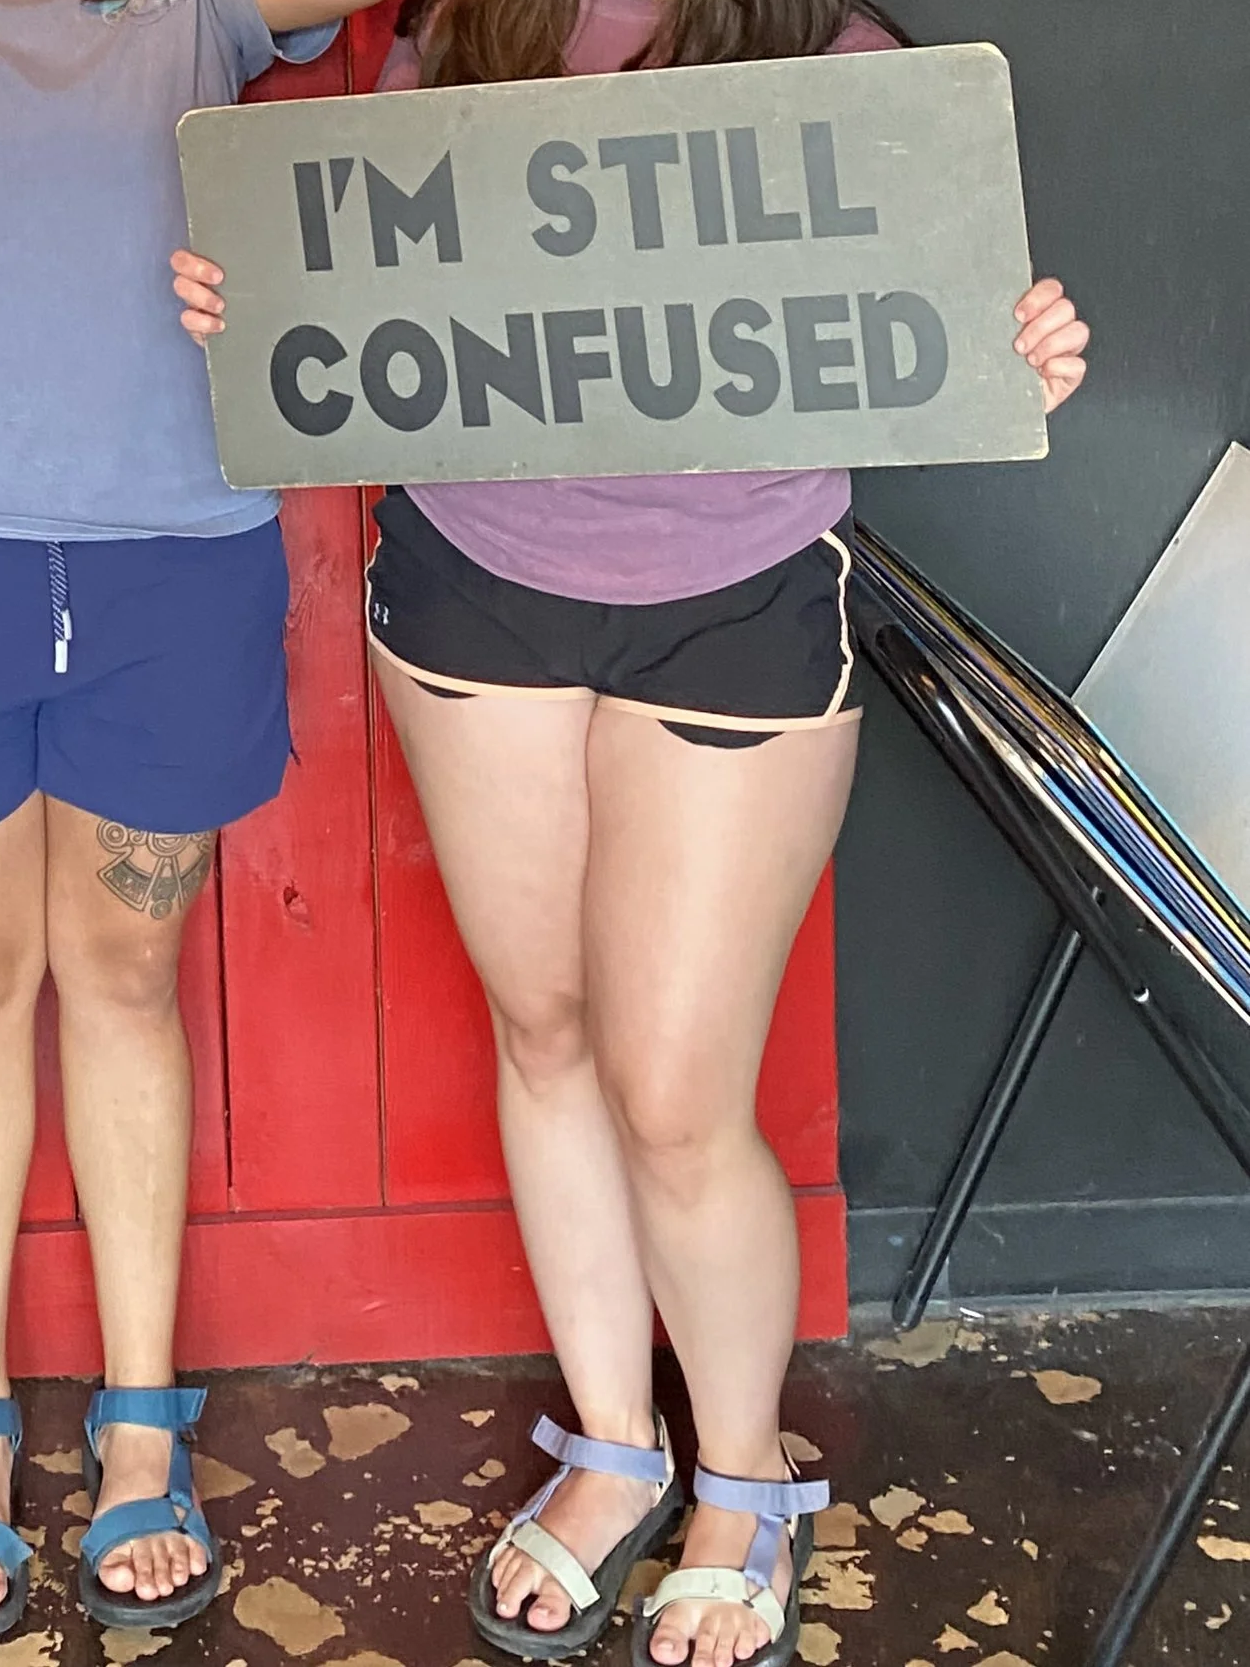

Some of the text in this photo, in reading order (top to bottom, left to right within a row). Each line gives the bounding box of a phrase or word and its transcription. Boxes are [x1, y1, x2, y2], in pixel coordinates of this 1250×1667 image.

[292, 121, 879, 272] I'M STILL
[270, 291, 949, 437] CONFUSED
